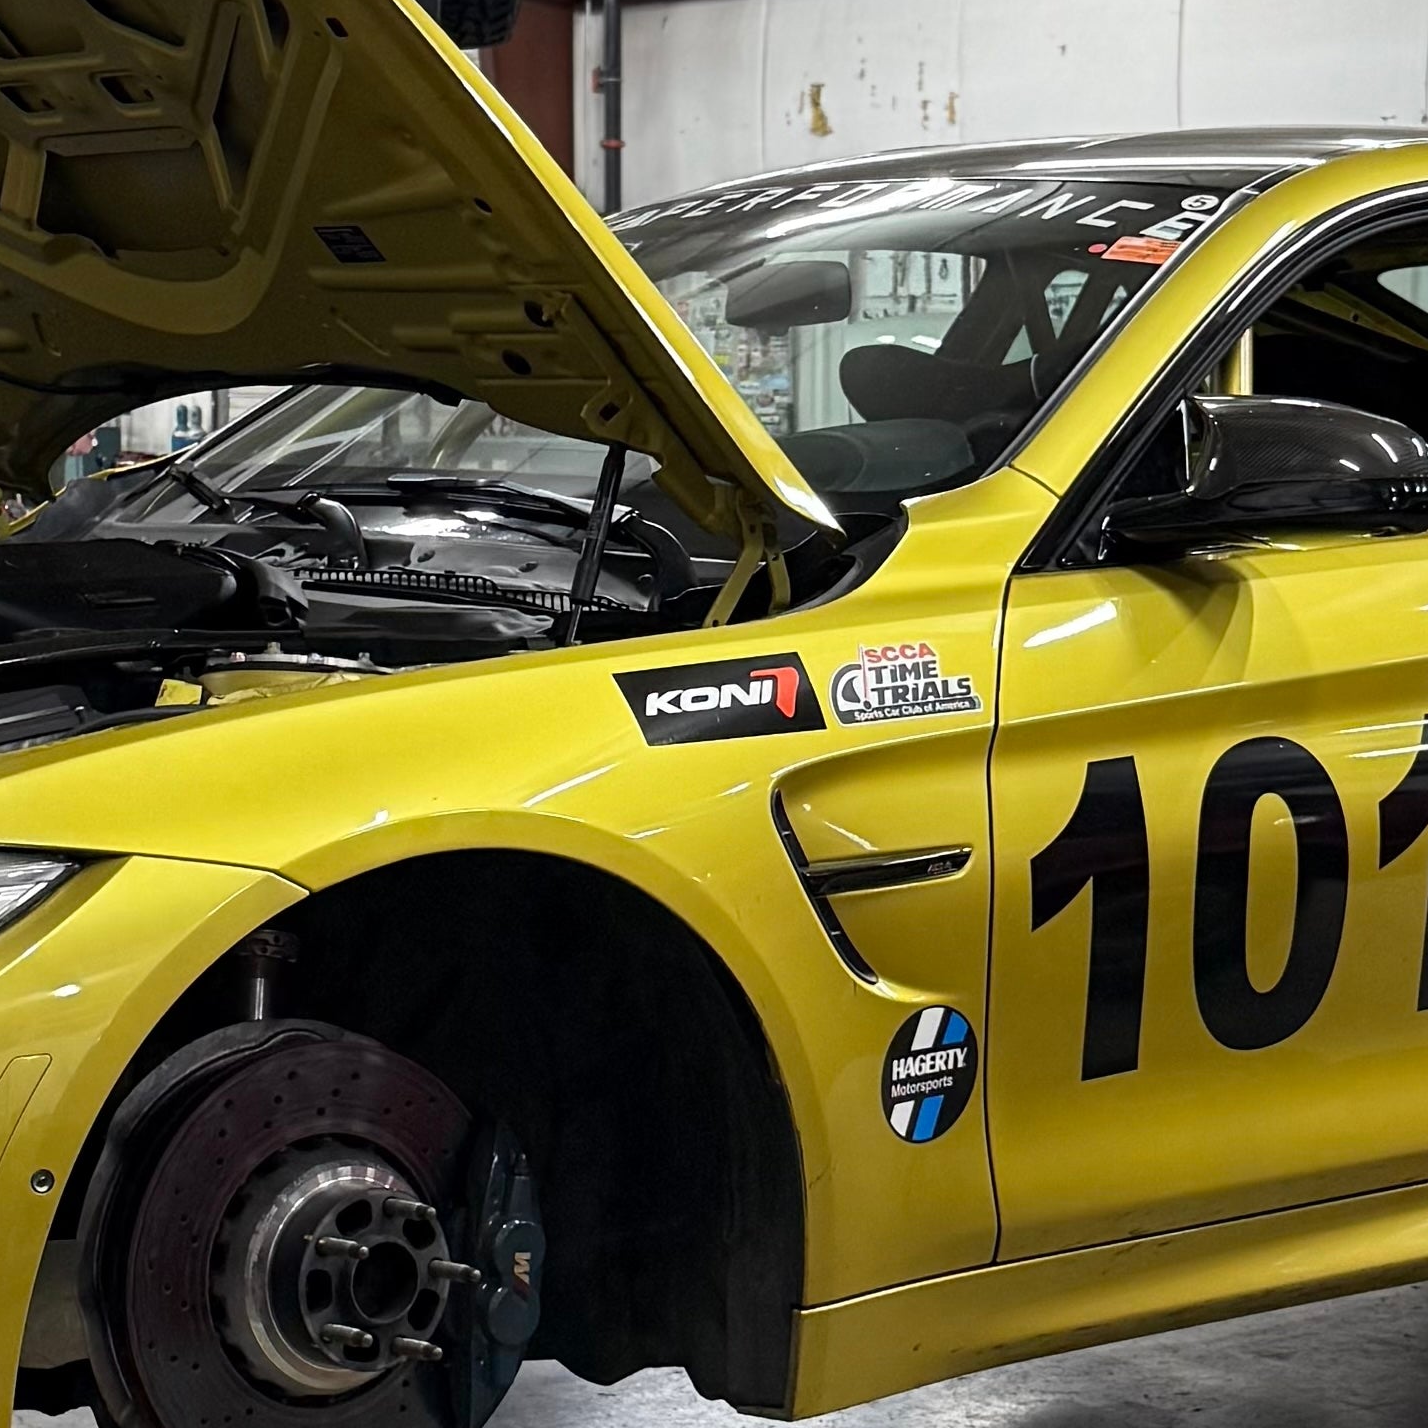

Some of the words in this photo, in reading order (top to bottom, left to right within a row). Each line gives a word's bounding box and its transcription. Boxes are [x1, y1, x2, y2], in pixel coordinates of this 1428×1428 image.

[864, 643, 937, 663] SCCA
[645, 679, 773, 717] KONI
[854, 709, 884, 722] Sports
[885, 706, 900, 718] Car
[902, 703, 922, 715] Club
[924, 703, 933, 712] of
[935, 699, 971, 711] America
[892, 1047, 968, 1081] HAGERTY
[891, 1076, 953, 1098] Motorsports
